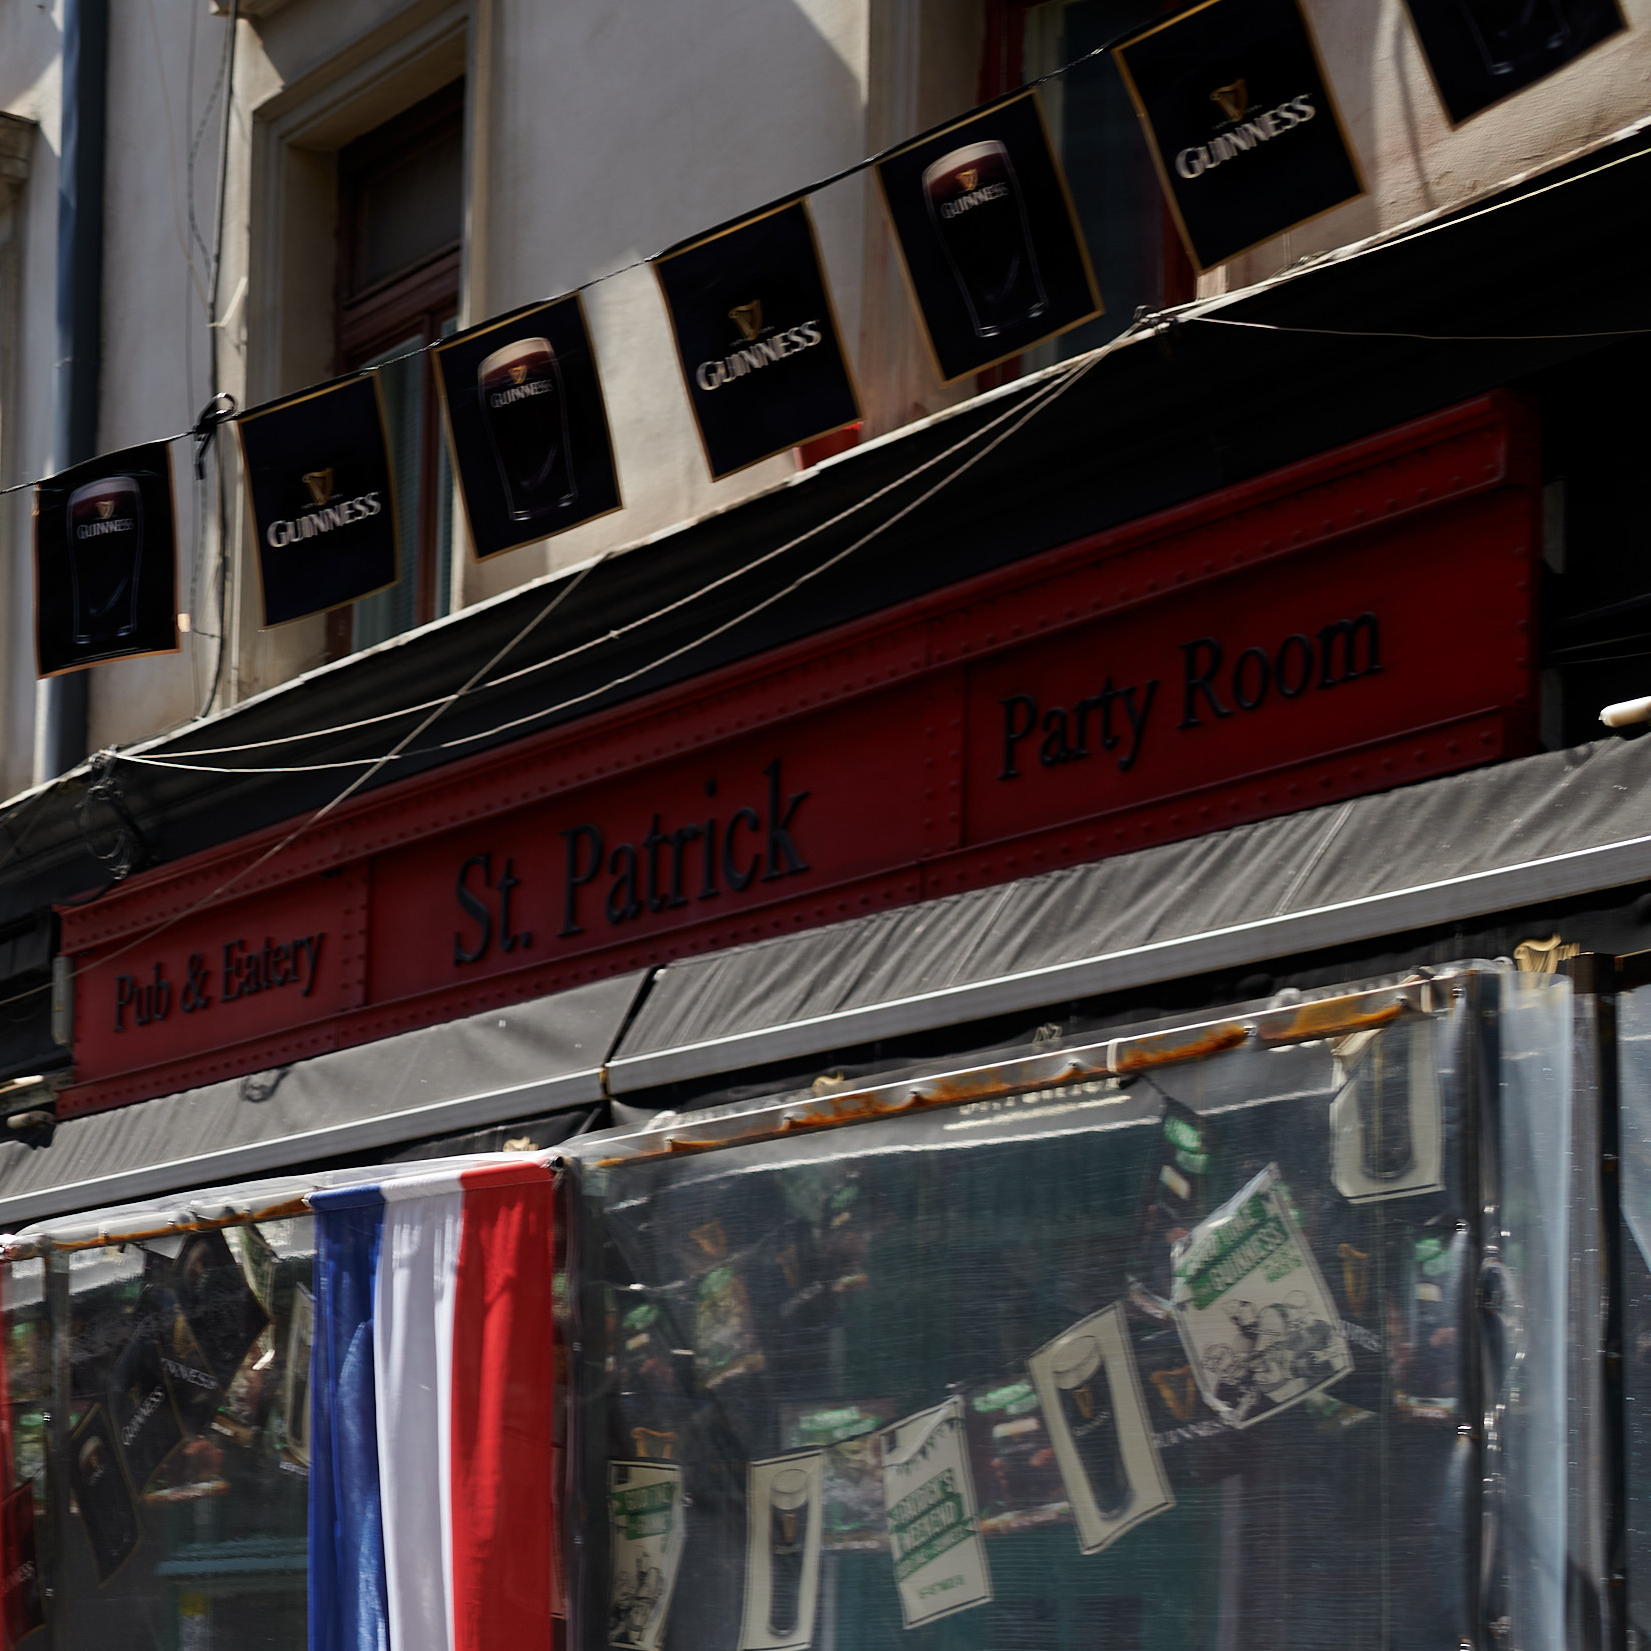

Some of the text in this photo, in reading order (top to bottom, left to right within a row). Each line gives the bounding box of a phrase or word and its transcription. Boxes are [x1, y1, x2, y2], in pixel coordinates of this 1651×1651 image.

[1175, 94, 1318, 180] GUINNESS
[940, 182, 1009, 219] GUINNESS
[696, 321, 822, 393] GUINNESS
[491, 380, 555, 409] GUINNESS
[77, 518, 135, 541] GUINNESS
[268, 490, 383, 549] GUINNESS
[998, 609, 1384, 782] Party Room
[453, 758, 812, 967] St. Patrick
[113, 930, 326, 1034] Pub & Eatery
